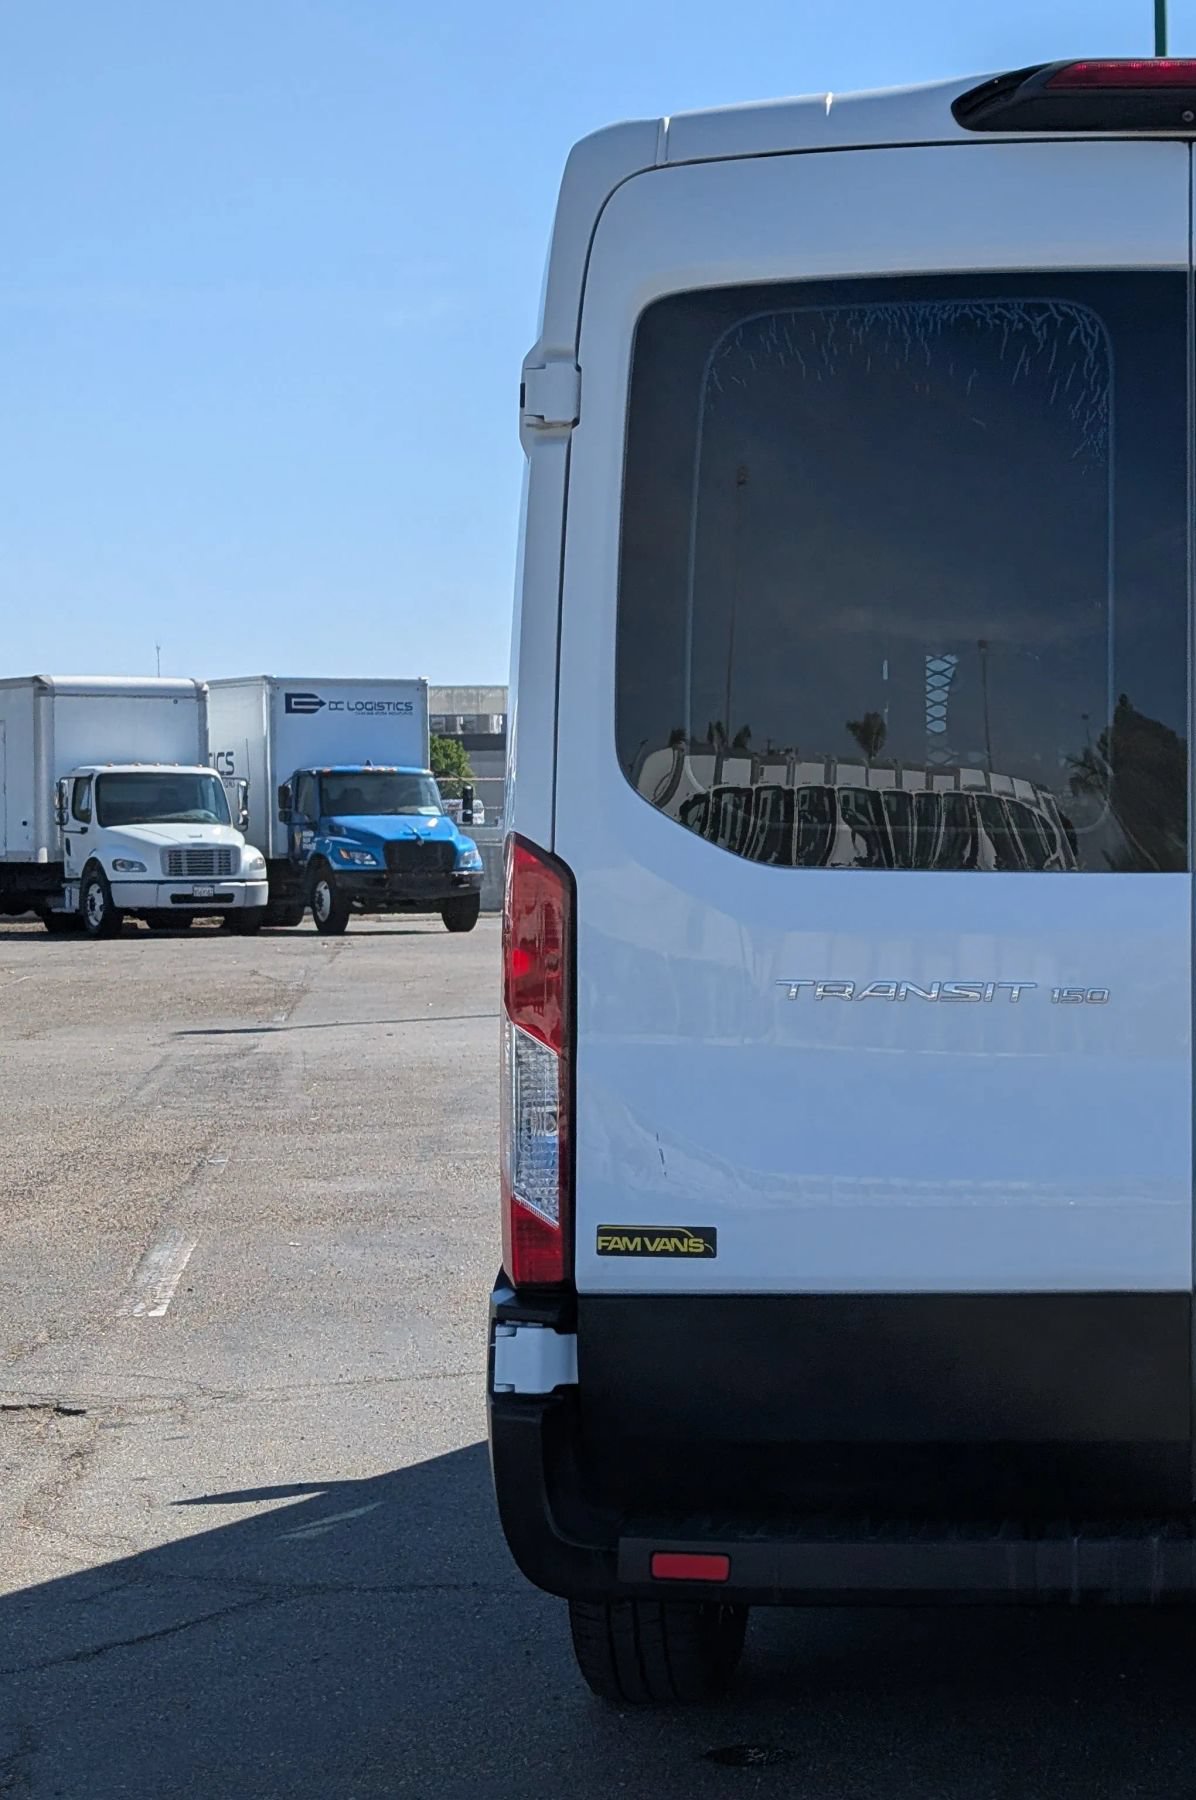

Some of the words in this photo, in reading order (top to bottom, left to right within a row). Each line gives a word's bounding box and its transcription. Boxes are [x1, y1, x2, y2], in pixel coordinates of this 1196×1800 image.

[328, 701, 344, 711] DC
[347, 701, 413, 711] LOGISTICS
[775, 979, 1038, 1003] TRANSIT
[1051, 987, 1111, 1004] 150
[597, 1236, 641, 1252] FAM
[643, 1237, 705, 1253] VANS
